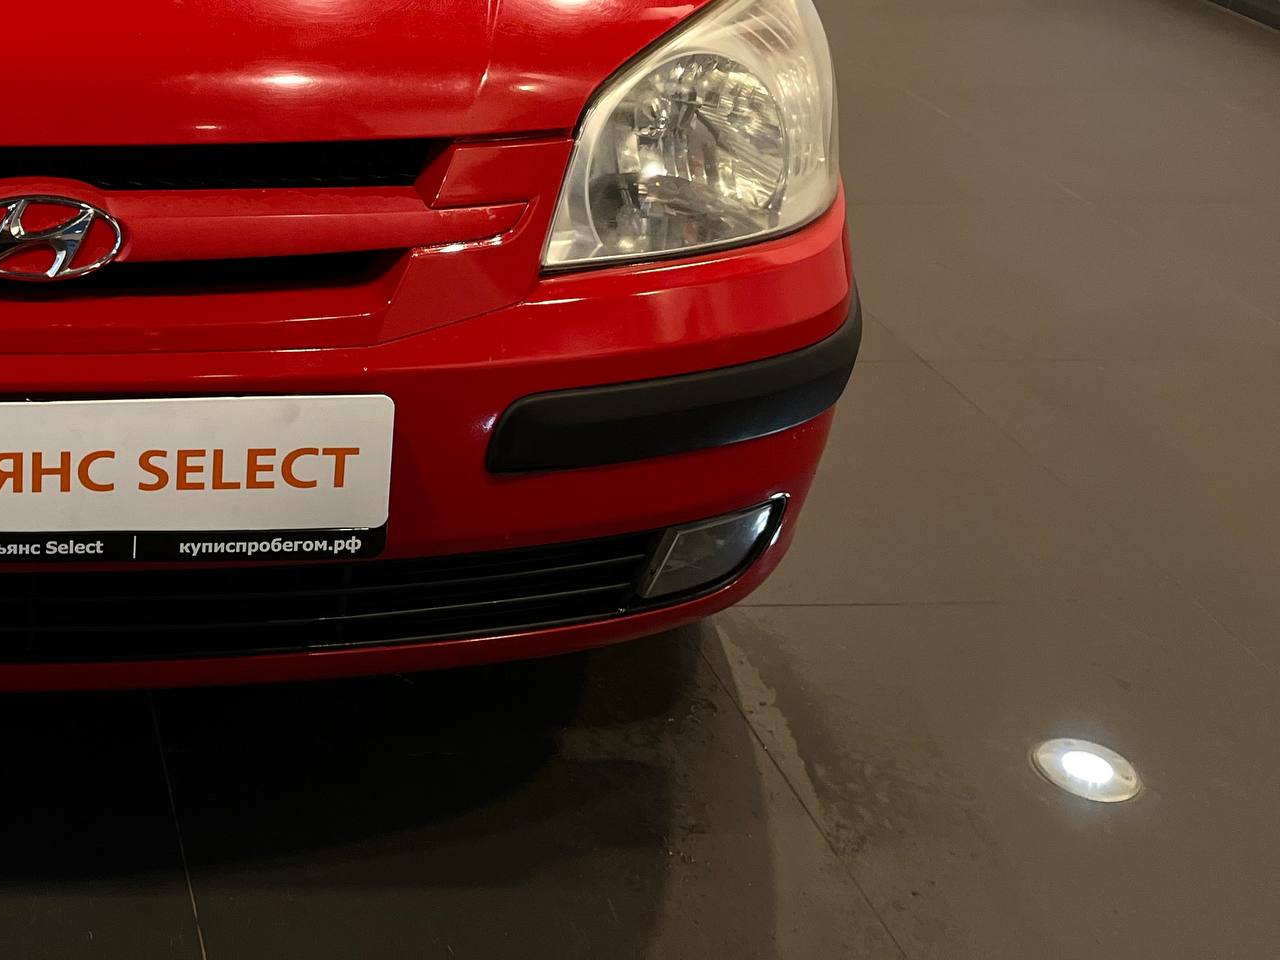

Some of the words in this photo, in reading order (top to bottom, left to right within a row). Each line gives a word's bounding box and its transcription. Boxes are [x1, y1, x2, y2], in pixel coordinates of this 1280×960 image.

[137, 446, 361, 491] SELECT
[45, 539, 104, 555] Select
[179, 536, 362, 556] куписпробегом.рф
